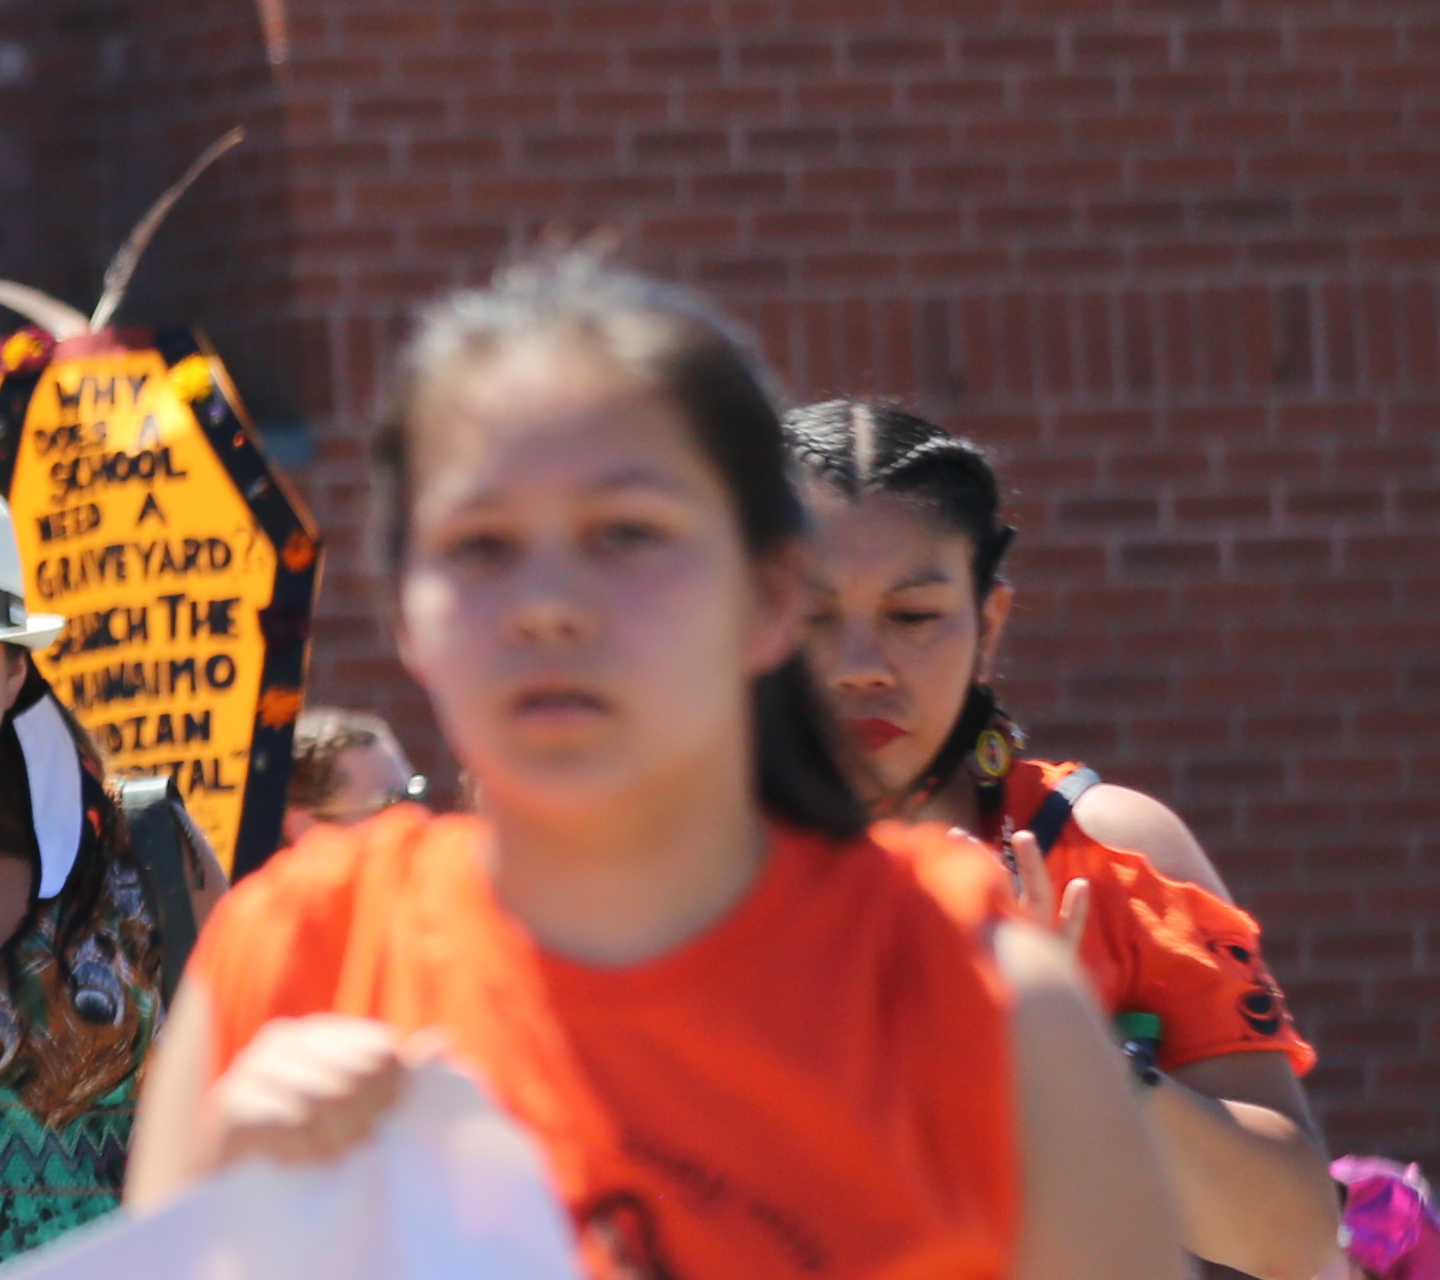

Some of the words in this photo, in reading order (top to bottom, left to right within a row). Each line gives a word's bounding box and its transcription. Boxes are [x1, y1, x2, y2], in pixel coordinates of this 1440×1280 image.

[55, 374, 149, 410] WHY
[50, 446, 188, 504] SCHOOL
[136, 491, 167, 527] A
[157, 593, 242, 639] THE
[95, 709, 211, 755] DIAN
